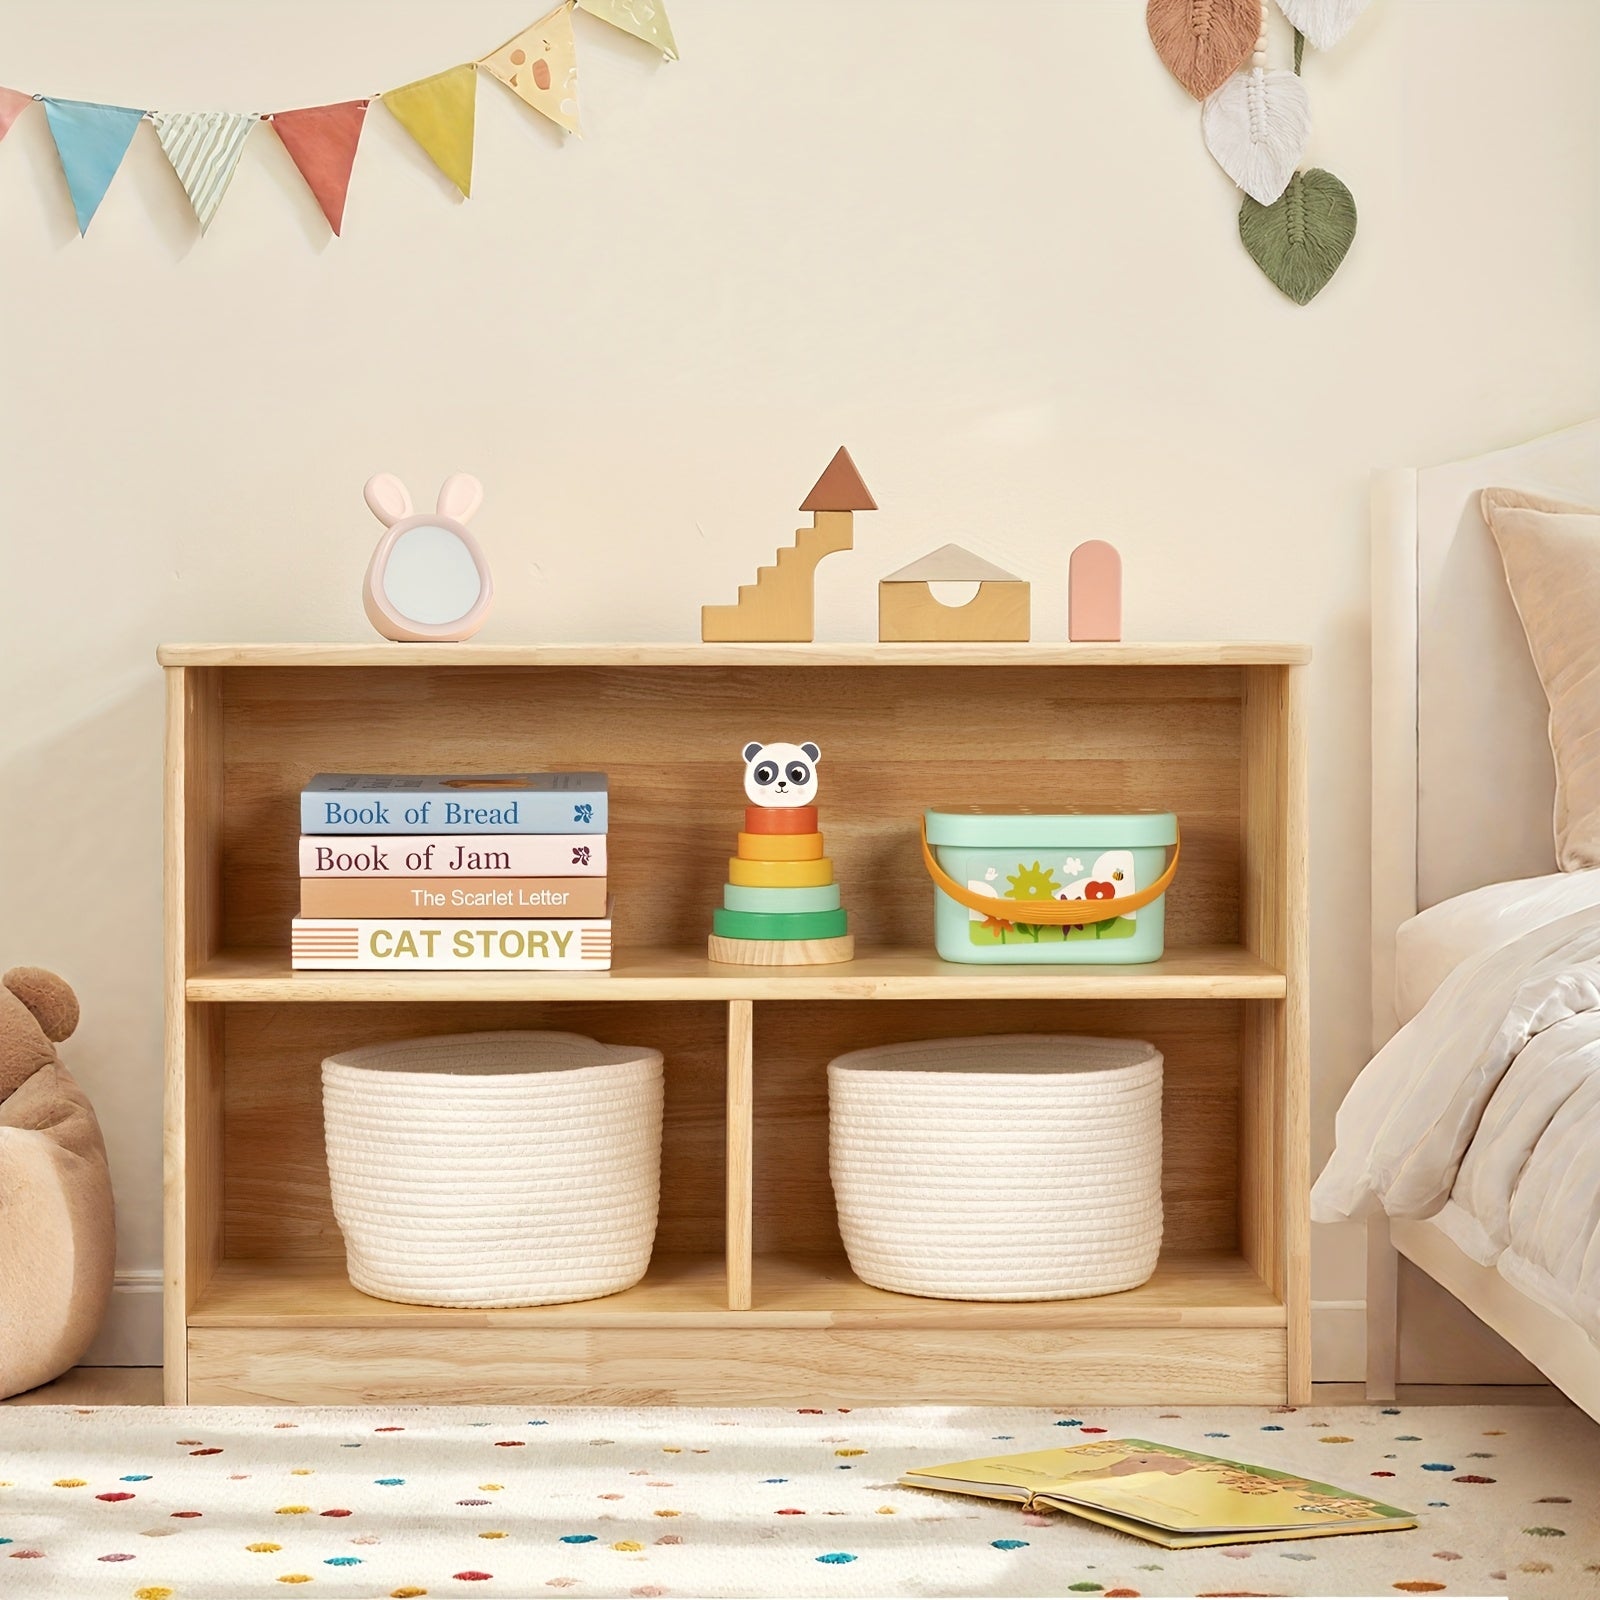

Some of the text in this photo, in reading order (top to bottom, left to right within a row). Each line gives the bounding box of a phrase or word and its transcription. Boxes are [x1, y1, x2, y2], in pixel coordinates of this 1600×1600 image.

[324, 801, 520, 825] Book of Bread
[315, 844, 512, 872] Book of Jam
[411, 889, 569, 906] The Scarlet Letter
[370, 930, 573, 958] CAT STORY
